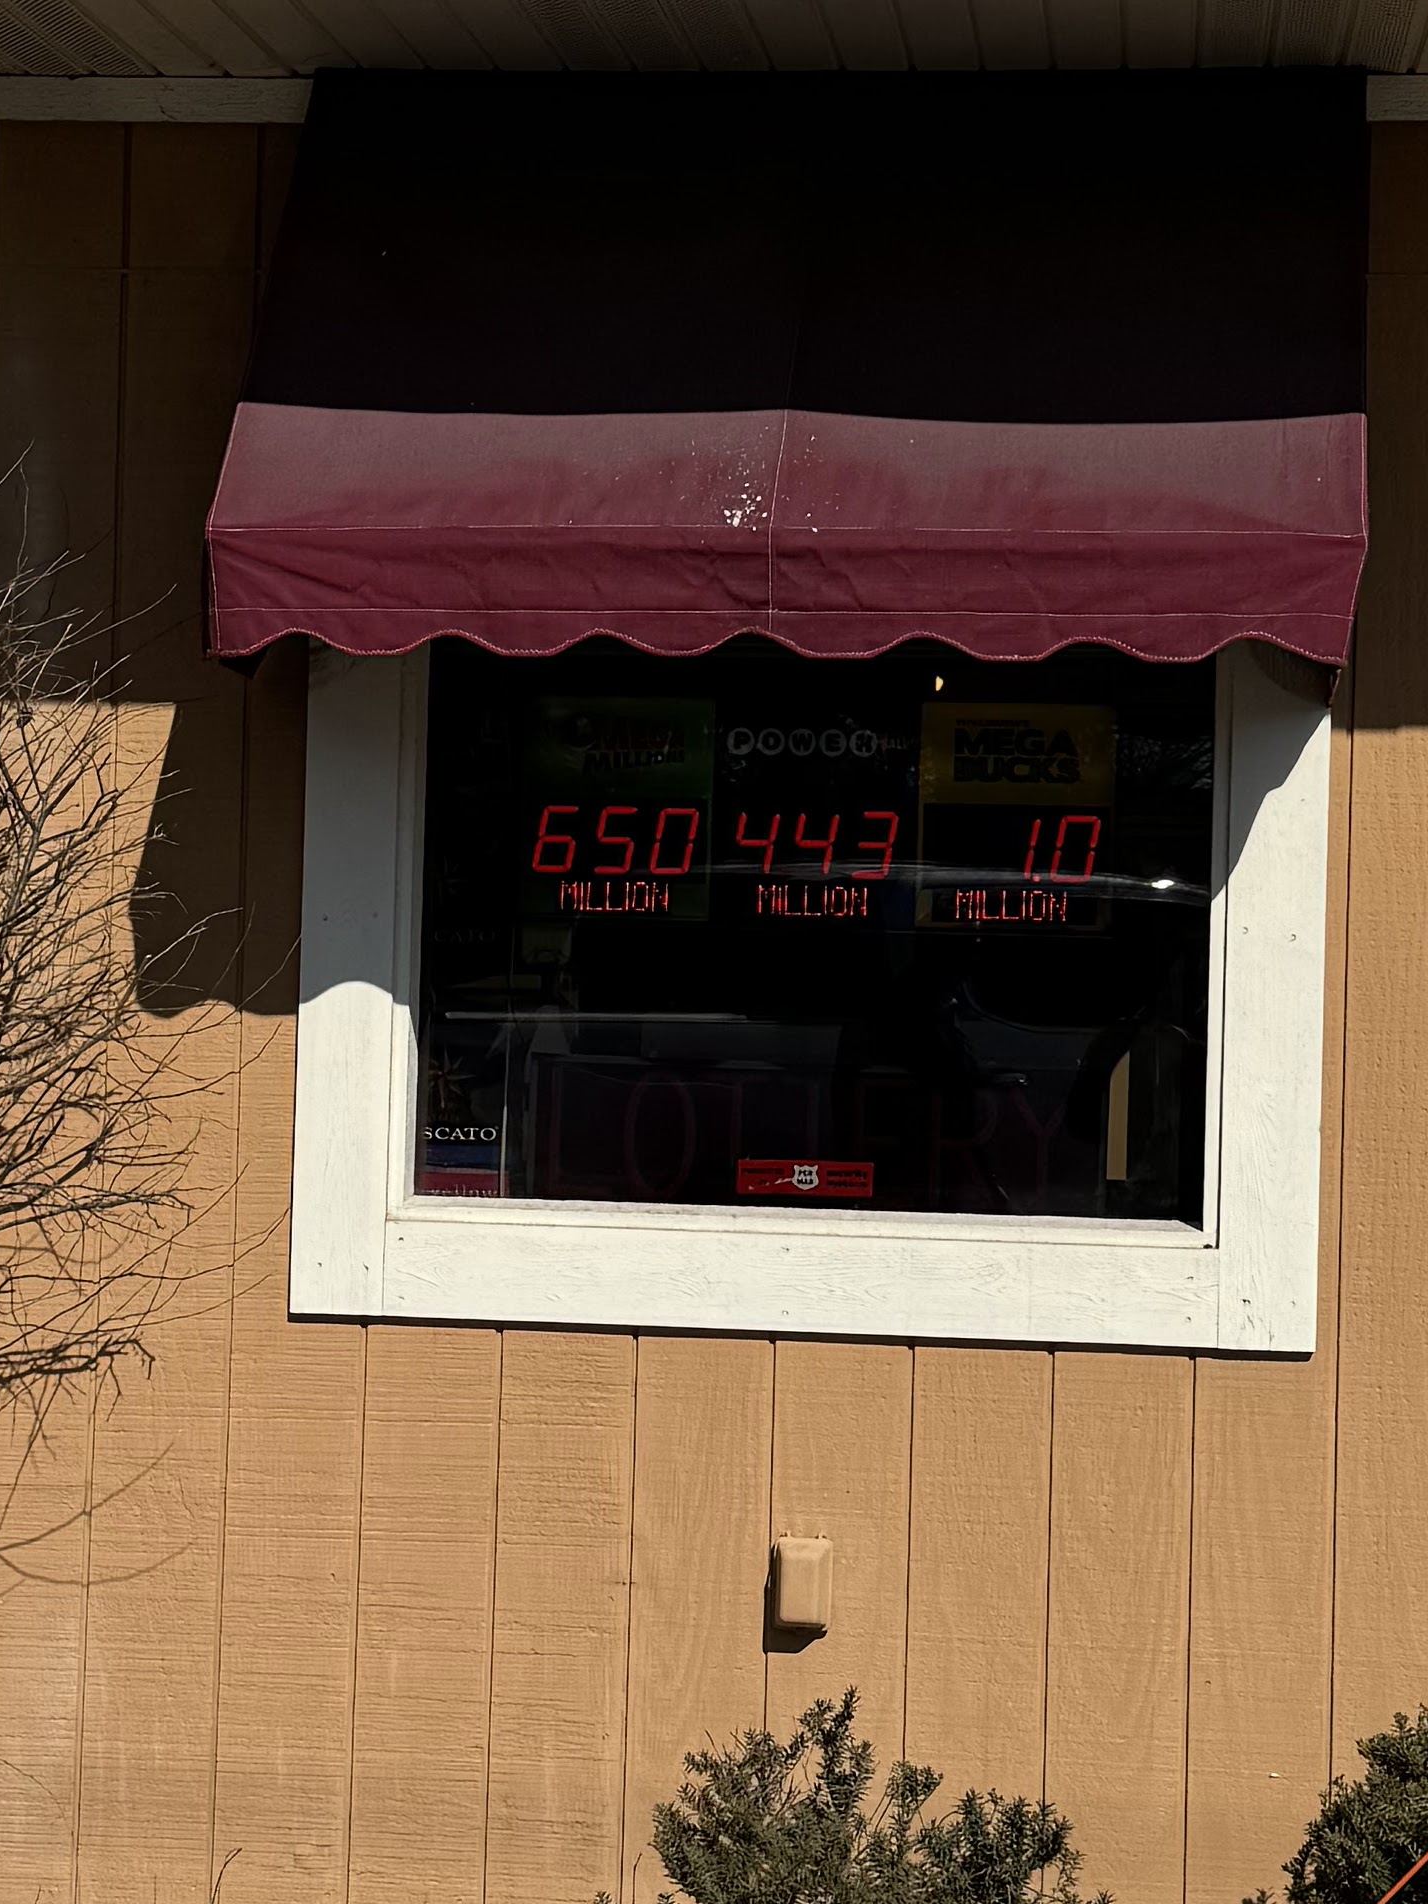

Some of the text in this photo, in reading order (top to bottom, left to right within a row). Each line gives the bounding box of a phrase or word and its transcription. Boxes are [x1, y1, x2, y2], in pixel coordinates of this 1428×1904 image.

[954, 728, 1078, 754] MEGA
[532, 805, 699, 875] 650
[735, 812, 900, 881] 443
[559, 881, 670, 912] MILLION
[756, 884, 868, 917] MILLION
[954, 890, 1067, 922] MILLION
